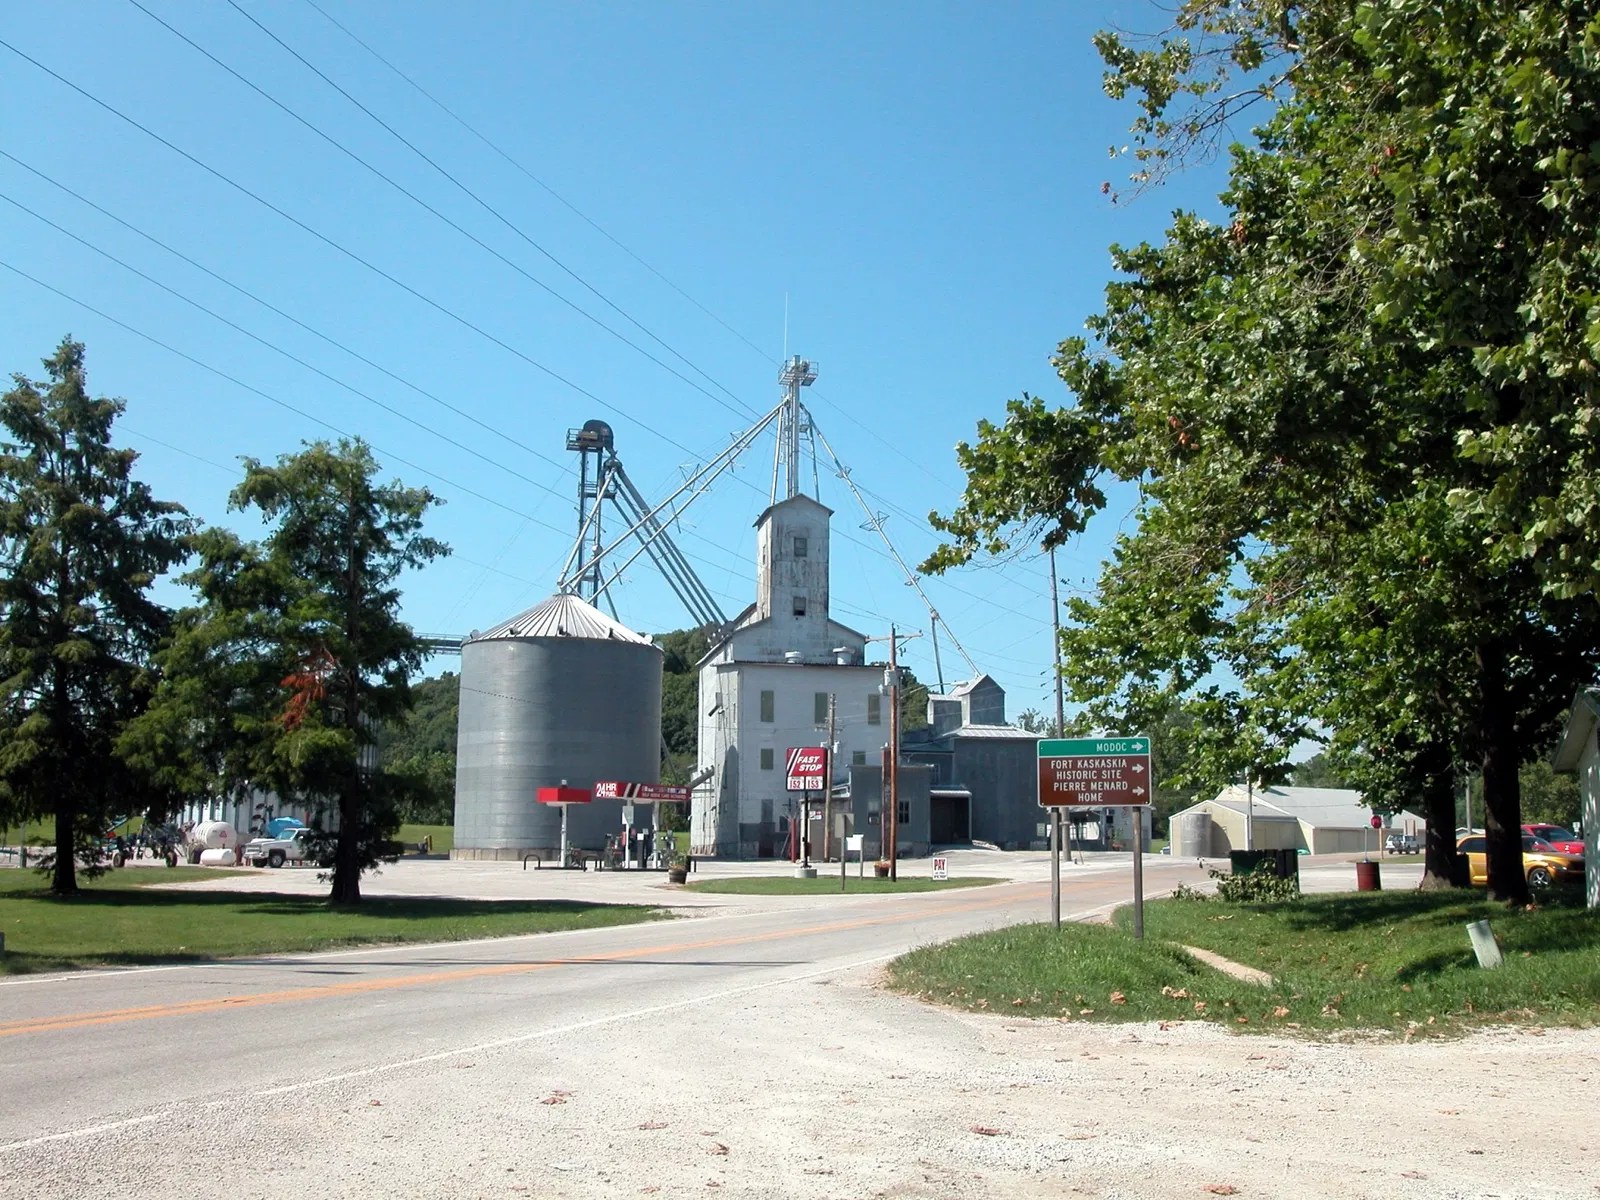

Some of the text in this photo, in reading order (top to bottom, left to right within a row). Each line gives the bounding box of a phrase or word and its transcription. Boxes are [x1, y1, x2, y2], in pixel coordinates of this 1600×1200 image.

[1096, 743, 1127, 752] MODOC
[1051, 759, 1127, 769] FORT KASKASKIA
[1056, 770, 1122, 780] HISTORIC SITE
[596, 783, 617, 797] 24 HR
[1053, 781, 1128, 791] PIERRE MENARD
[1078, 793, 1103, 802] HOME
